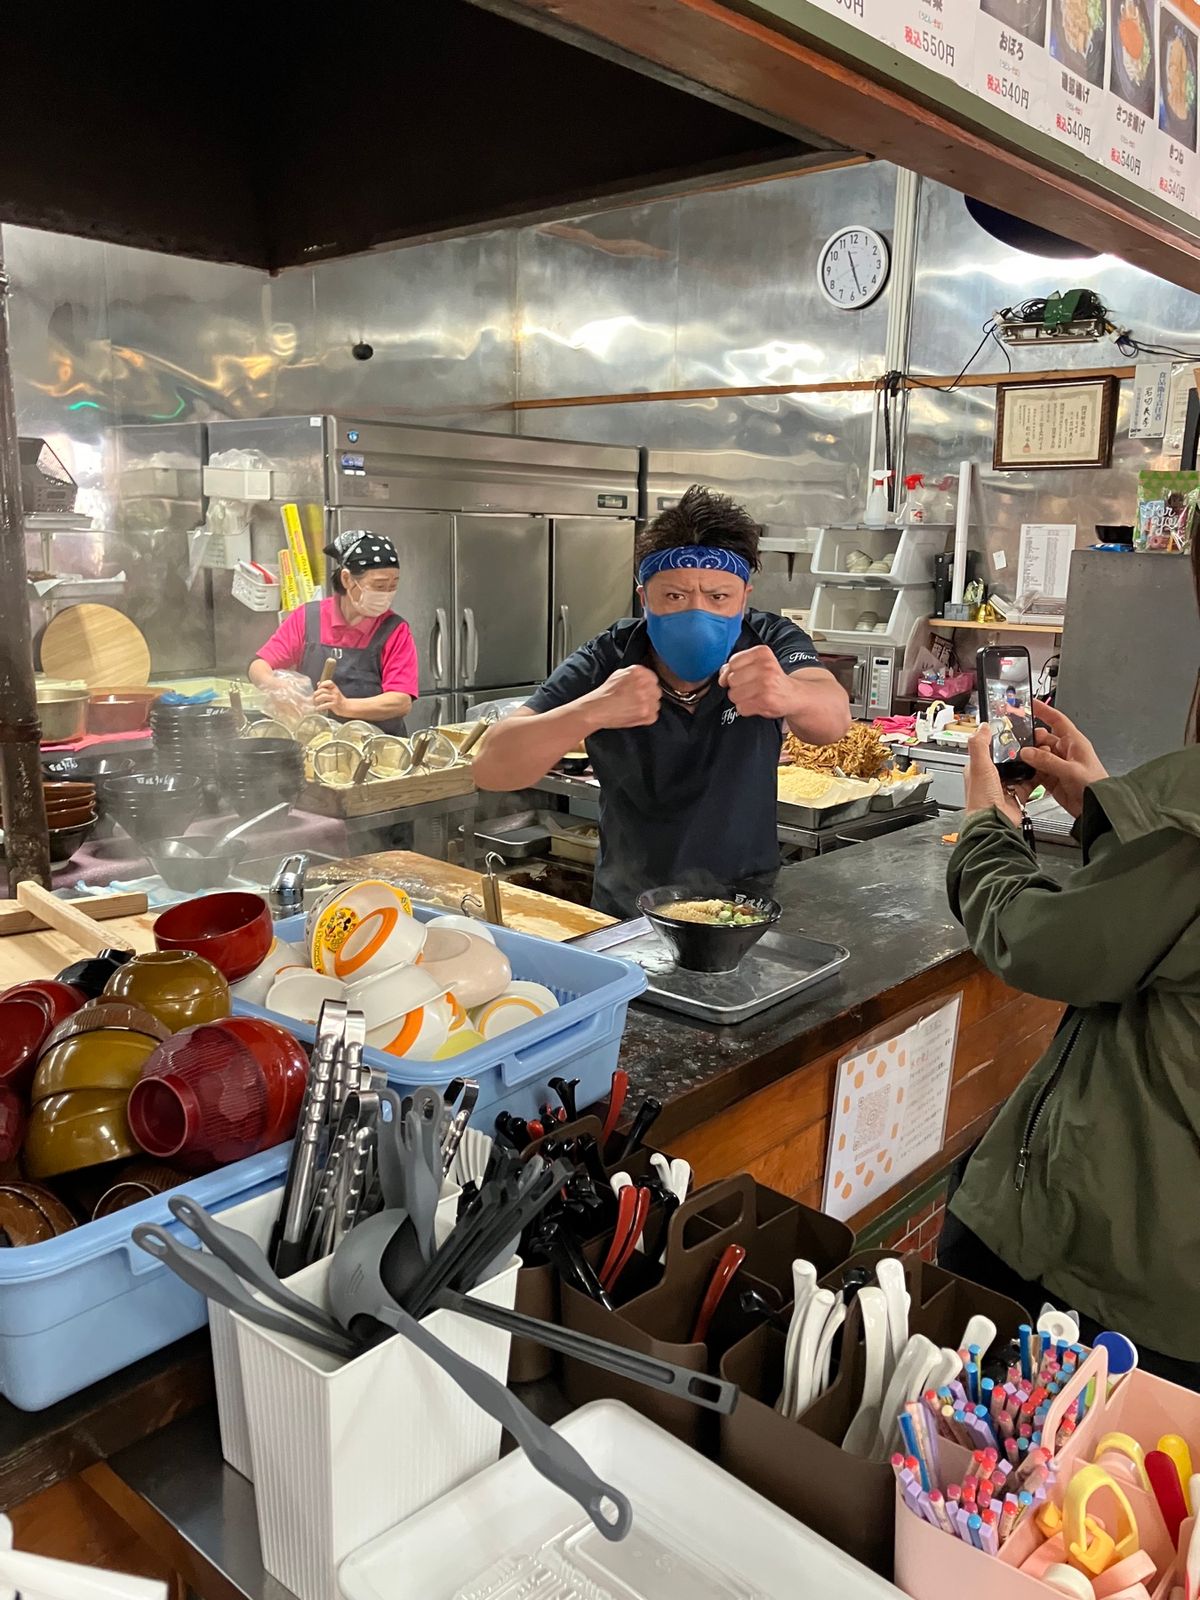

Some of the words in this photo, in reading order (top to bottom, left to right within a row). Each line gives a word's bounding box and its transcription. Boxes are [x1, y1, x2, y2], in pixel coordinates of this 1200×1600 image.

[850, 233, 859, 244] 12
[864, 236, 868, 246] 1
[839, 239, 846, 249] 11
[830, 250, 839, 261] 10
[872, 246, 878, 256] 2
[876, 260, 882, 270] 3
[826, 266, 832, 276] 9
[872, 274, 876, 284] 4
[830, 280, 835, 290] 8
[838, 289, 844, 299] 7
[862, 286, 868, 296] 5
[850, 291, 855, 302] 6
